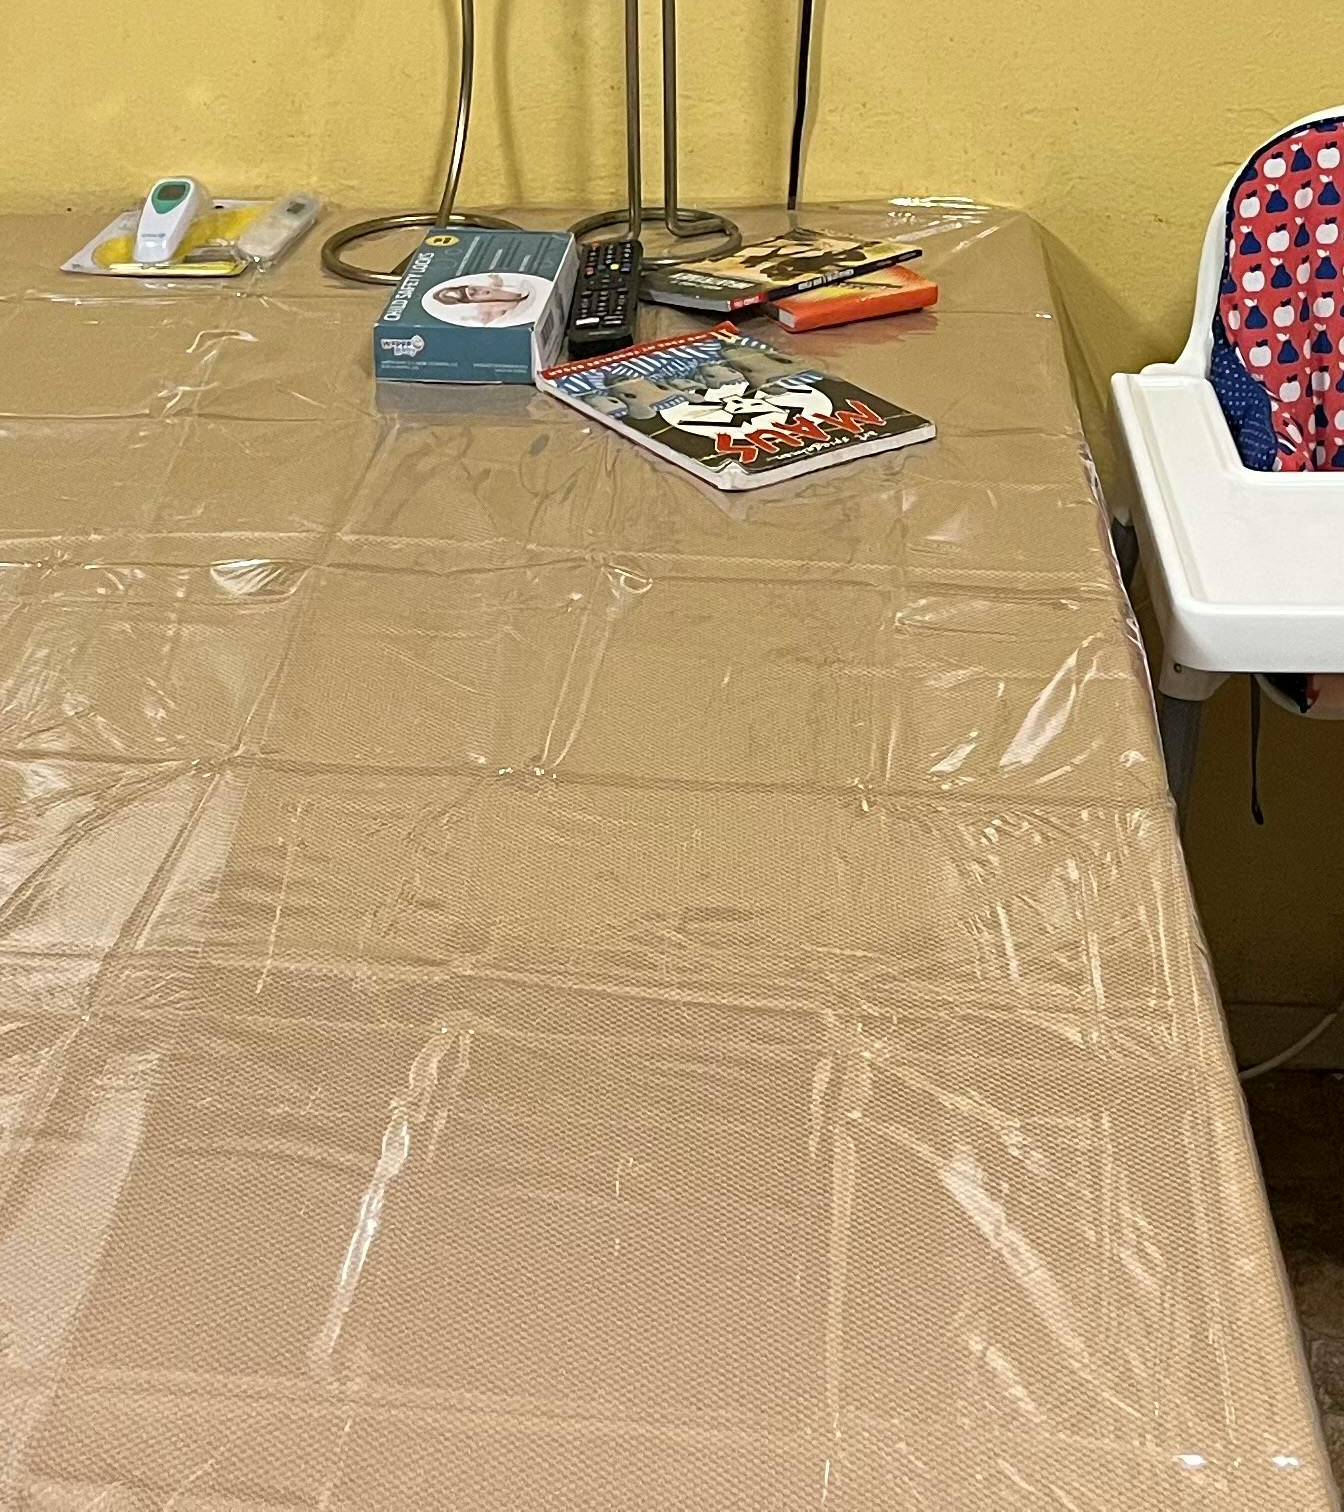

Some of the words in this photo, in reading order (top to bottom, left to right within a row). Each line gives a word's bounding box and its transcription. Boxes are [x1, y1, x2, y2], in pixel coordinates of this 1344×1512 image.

[408, 252, 435, 273] LOCKS
[395, 273, 424, 299] SAFETY
[383, 299, 409, 321] CHILD
[714, 398, 887, 464] MAUS
